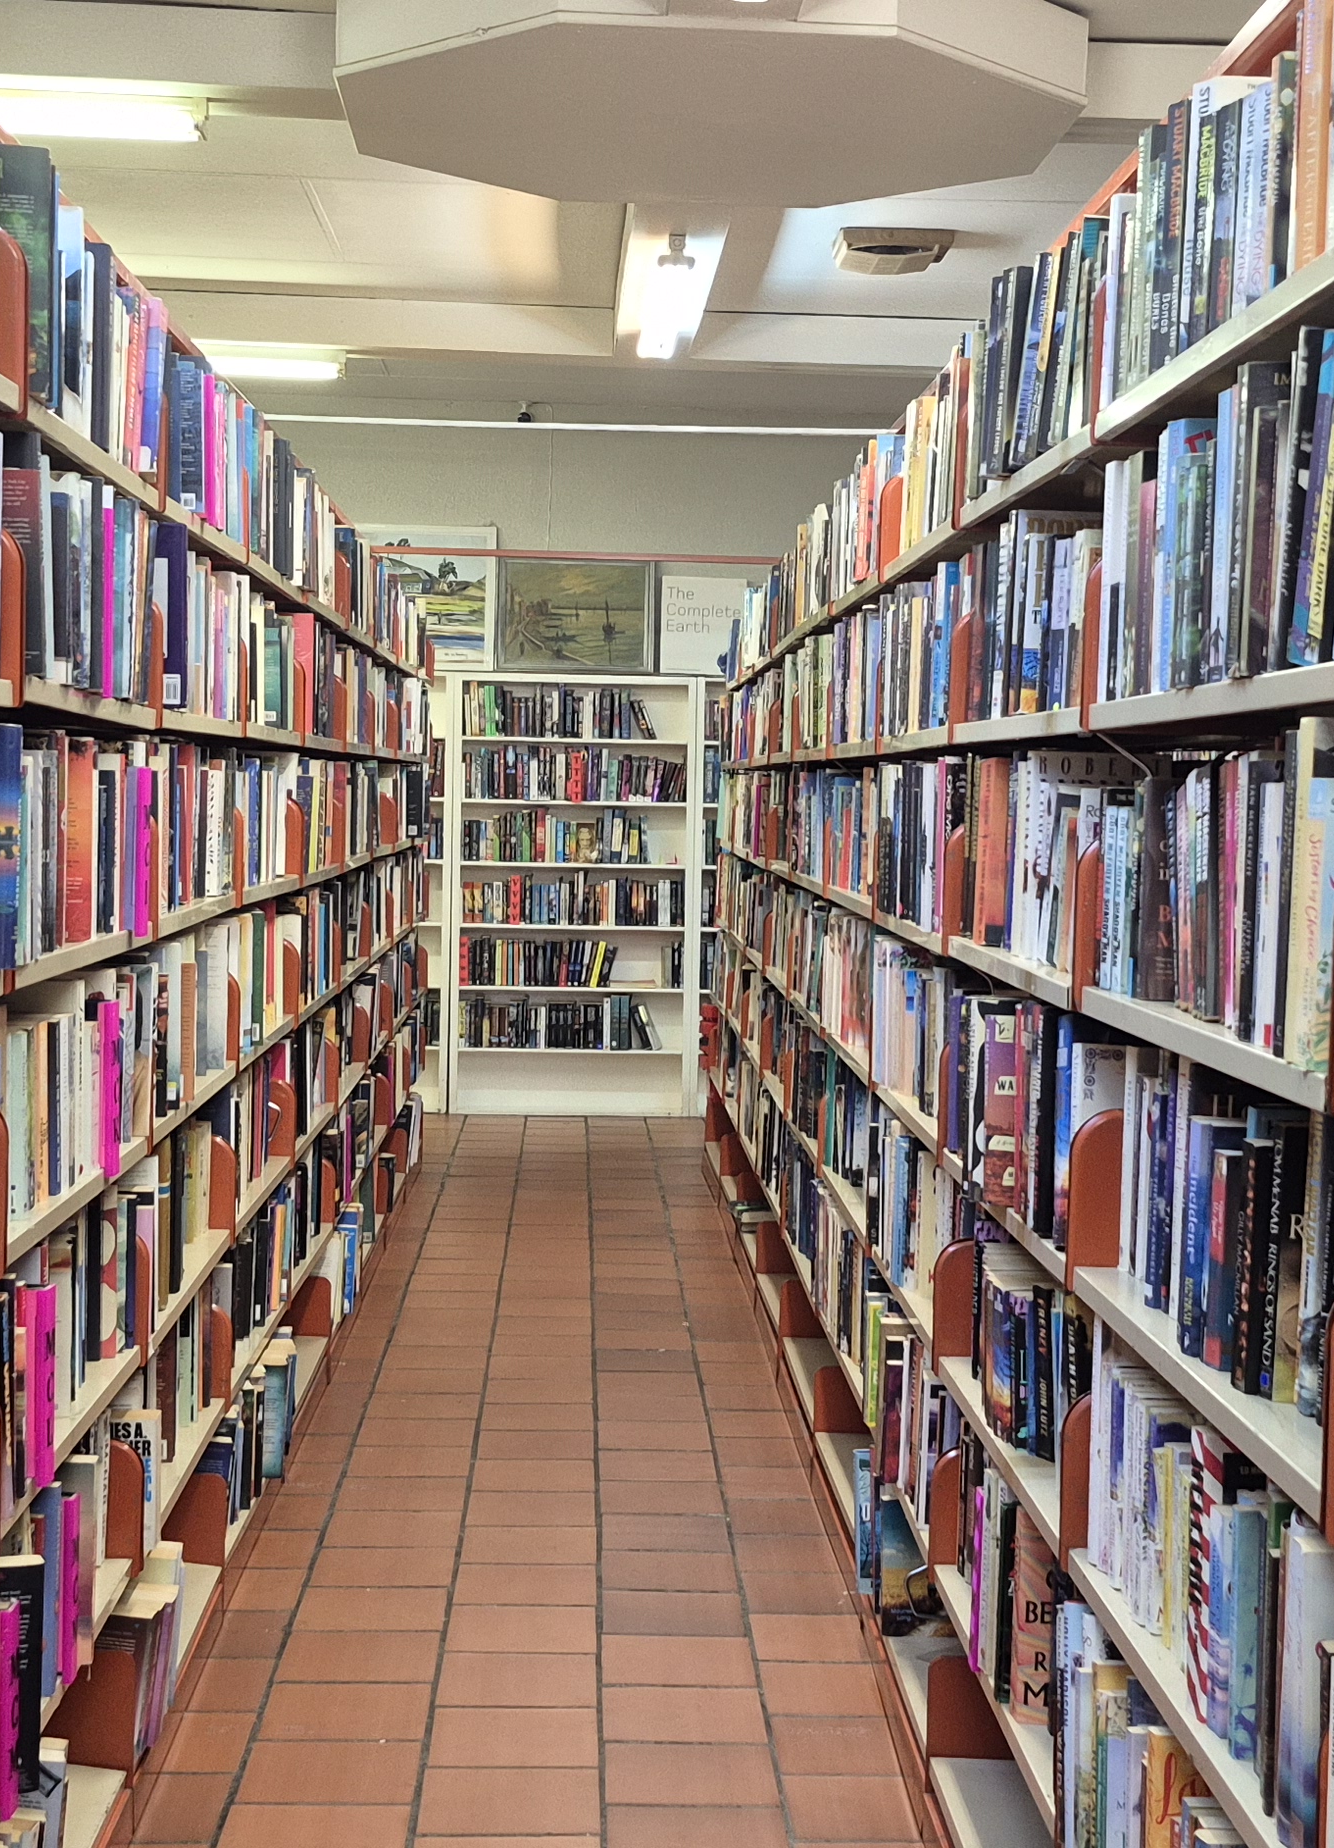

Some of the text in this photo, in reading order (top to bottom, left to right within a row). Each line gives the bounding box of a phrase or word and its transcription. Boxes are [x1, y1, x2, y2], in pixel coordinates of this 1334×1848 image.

[1217, 125, 1233, 199] MACBRIDE
[1188, 164, 1202, 238] MACBRIDE
[667, 586, 694, 600] The
[1312, 561, 1326, 611] DARK
[666, 602, 741, 621] Complete
[666, 619, 710, 633] Earth
[1261, 1316, 1275, 1366] SAND
